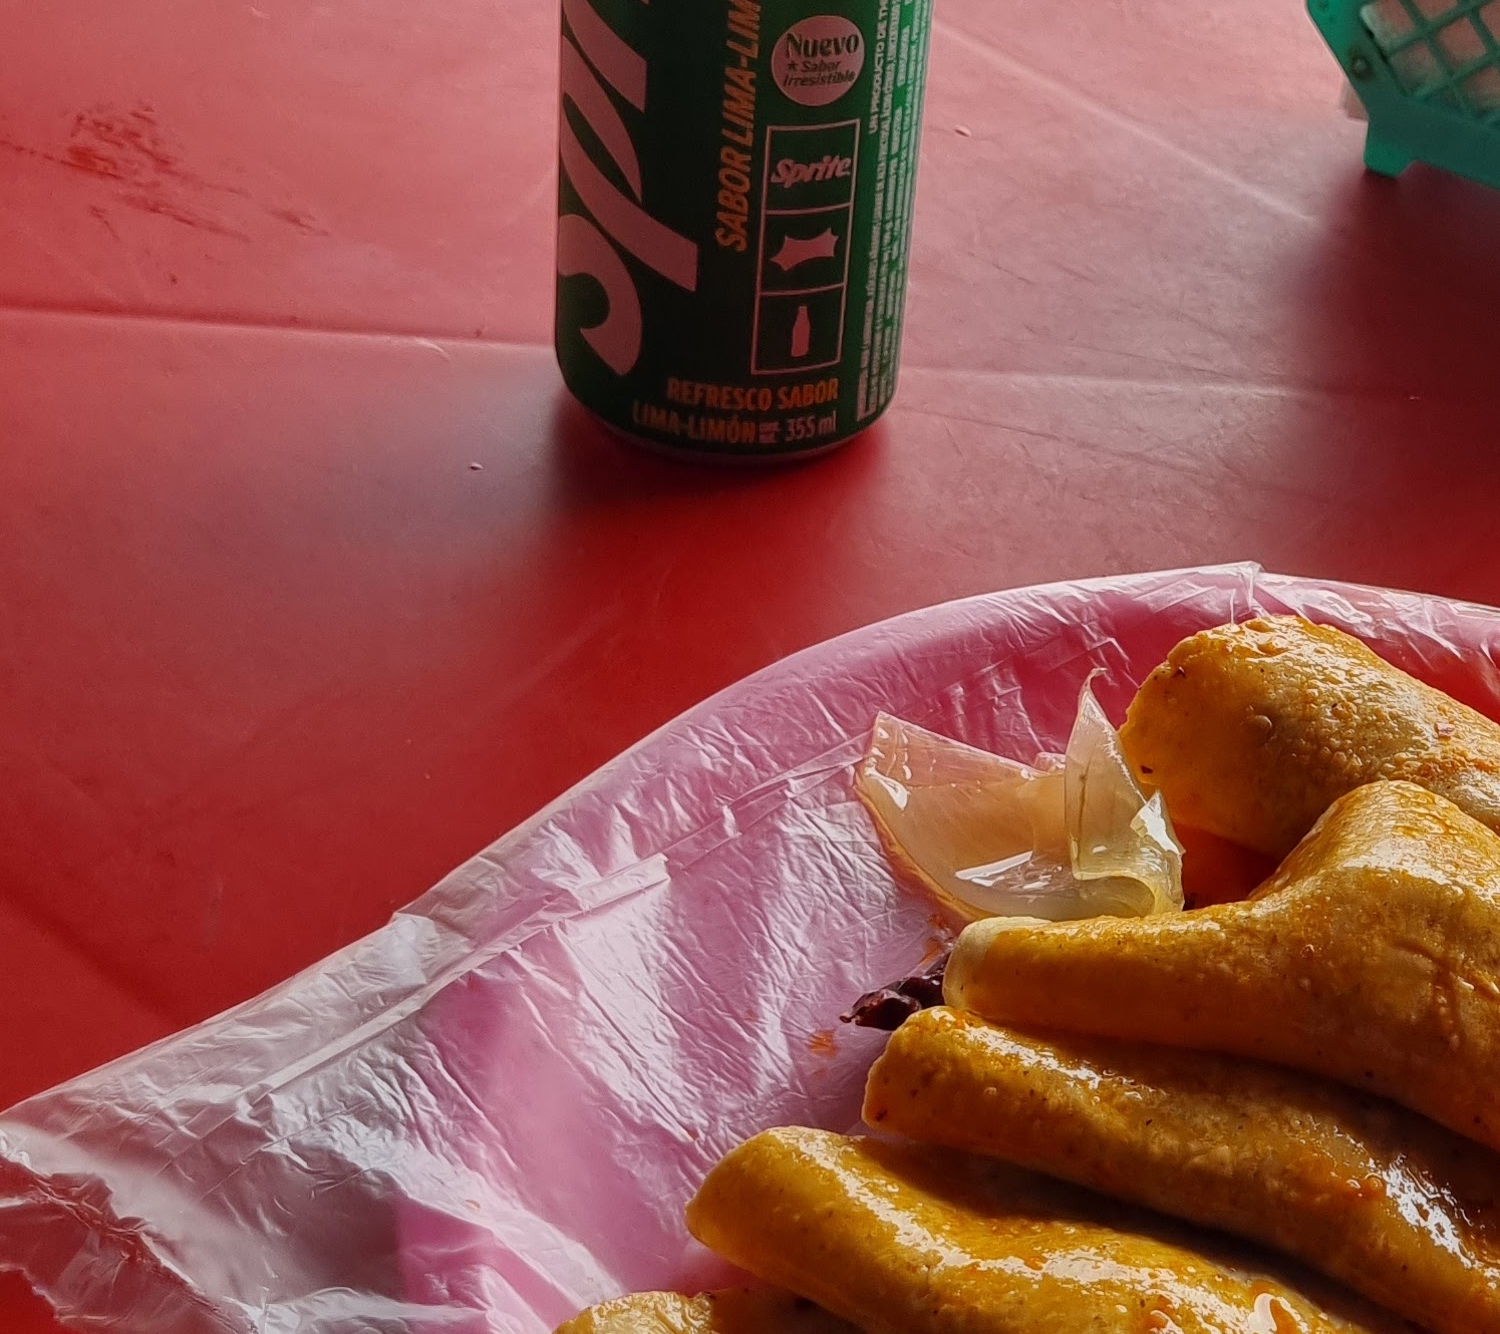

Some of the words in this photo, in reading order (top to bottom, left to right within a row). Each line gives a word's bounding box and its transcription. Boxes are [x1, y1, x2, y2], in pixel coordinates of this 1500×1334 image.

[876, 21, 887, 39] DE
[786, 33, 859, 58] Nuevo
[783, 69, 856, 86] Irresistible
[801, 60, 841, 73] Sabor
[872, 42, 884, 113] PRODUCTO
[869, 114, 878, 134] UN
[771, 155, 851, 189] Sprite
[715, 144, 752, 253] SABOR
[666, 377, 772, 412] REFRESCO
[777, 377, 839, 410] SABOR
[633, 399, 756, 443] LIMA-LIMÓN
[785, 417, 816, 443] 355
[819, 410, 837, 436] ml
